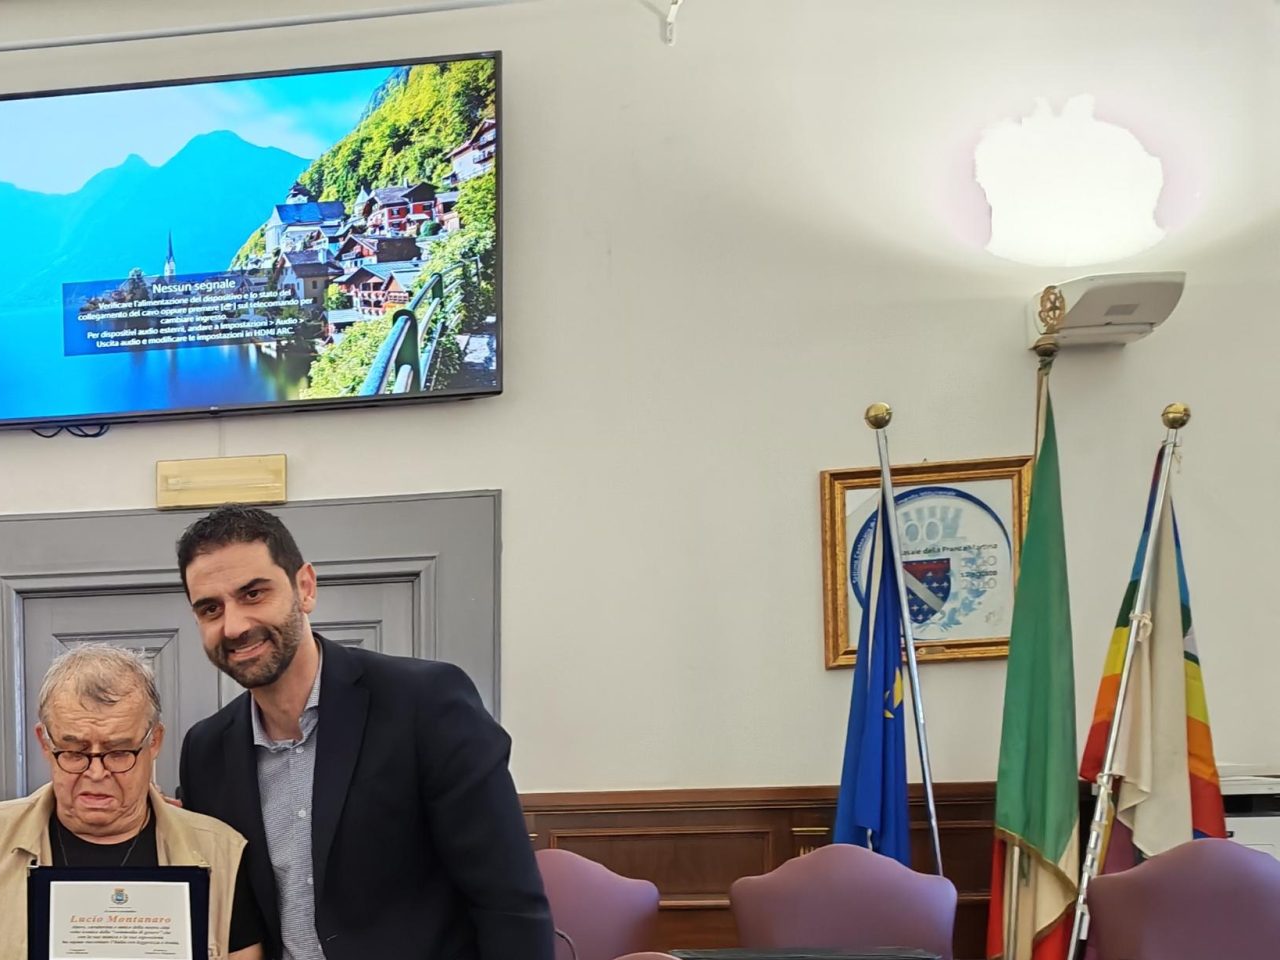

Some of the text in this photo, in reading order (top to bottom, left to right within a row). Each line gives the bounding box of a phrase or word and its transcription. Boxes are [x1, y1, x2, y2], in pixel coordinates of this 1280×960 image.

[152, 279, 236, 294] Nessun segnale
[70, 914, 172, 924] Lucio Montanaro
